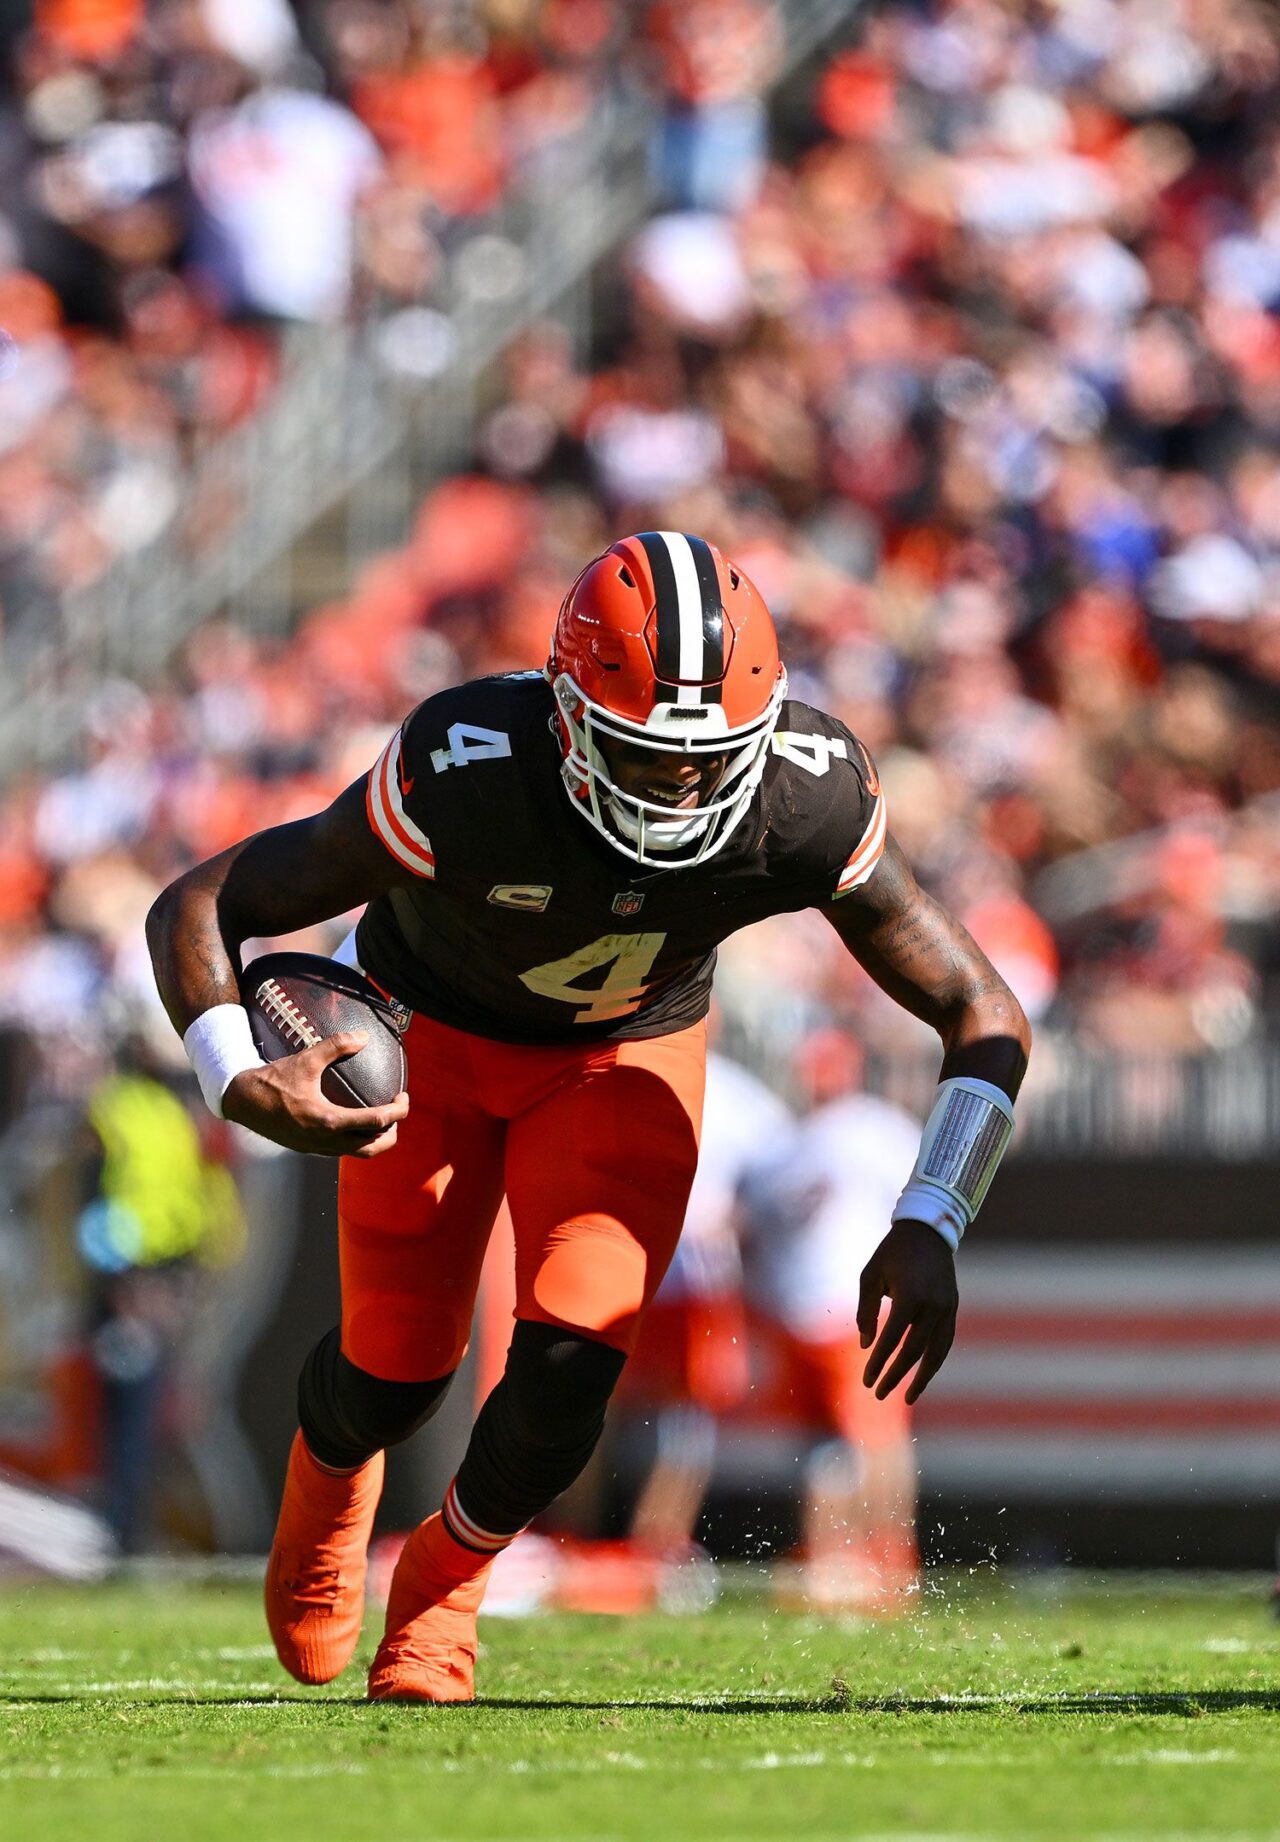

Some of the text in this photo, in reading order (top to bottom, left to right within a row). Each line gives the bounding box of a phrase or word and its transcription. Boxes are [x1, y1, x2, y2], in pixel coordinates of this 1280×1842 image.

[429, 722, 512, 774] 4
[772, 731, 848, 777] 4
[517, 932, 668, 1024] 4
